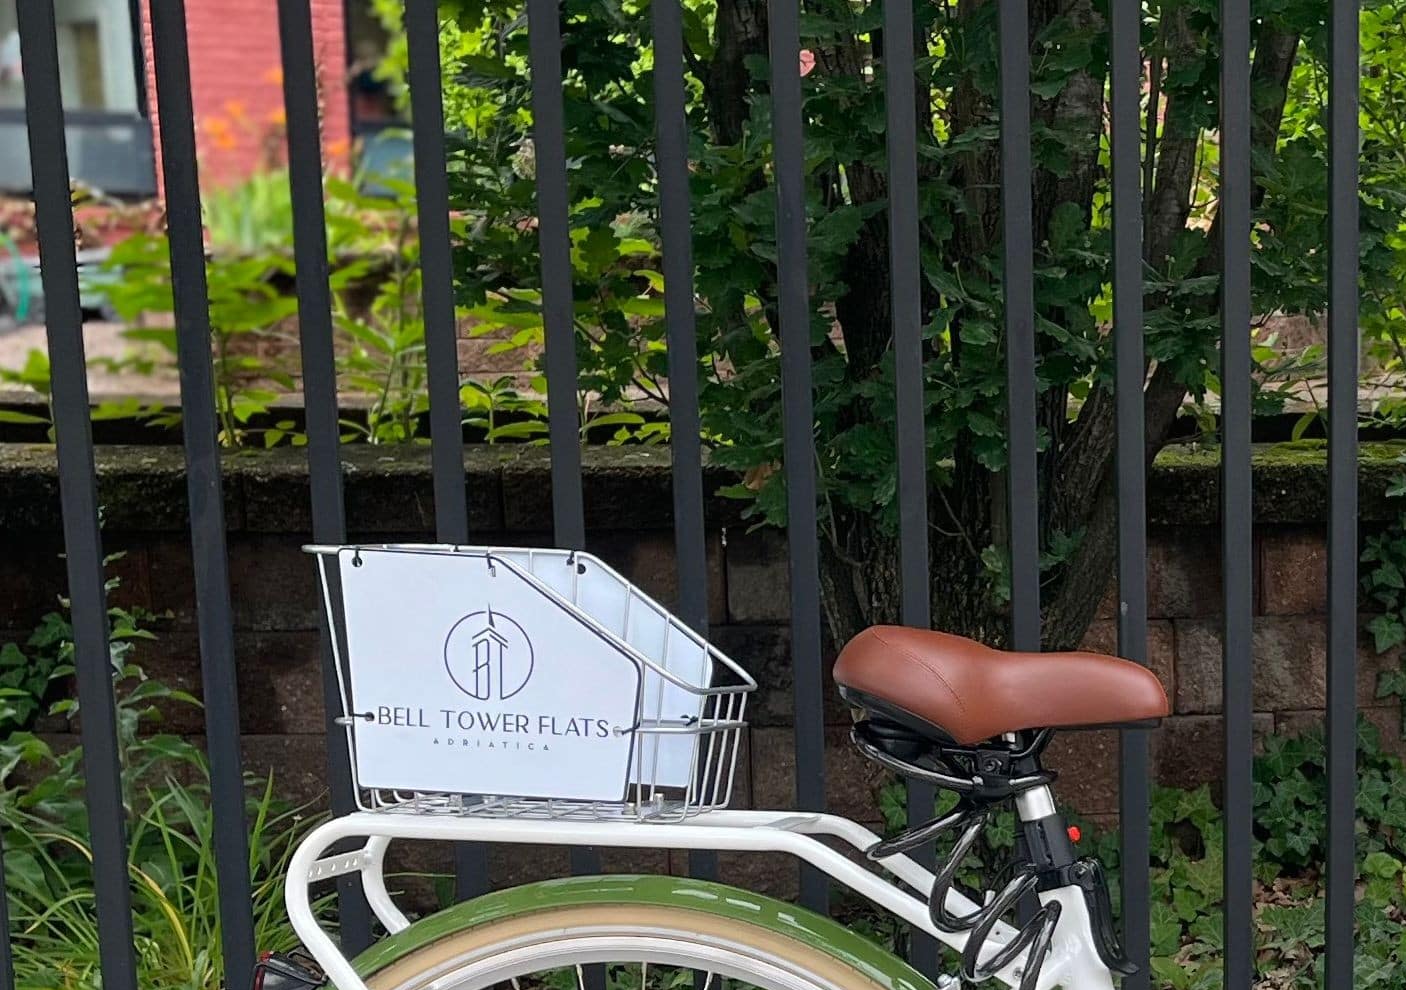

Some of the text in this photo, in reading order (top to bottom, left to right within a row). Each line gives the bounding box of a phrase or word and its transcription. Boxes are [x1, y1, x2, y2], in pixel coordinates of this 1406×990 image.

[378, 706, 609, 738] BELL TOWER FLATS
[433, 738, 549, 751] ADRIATICA
